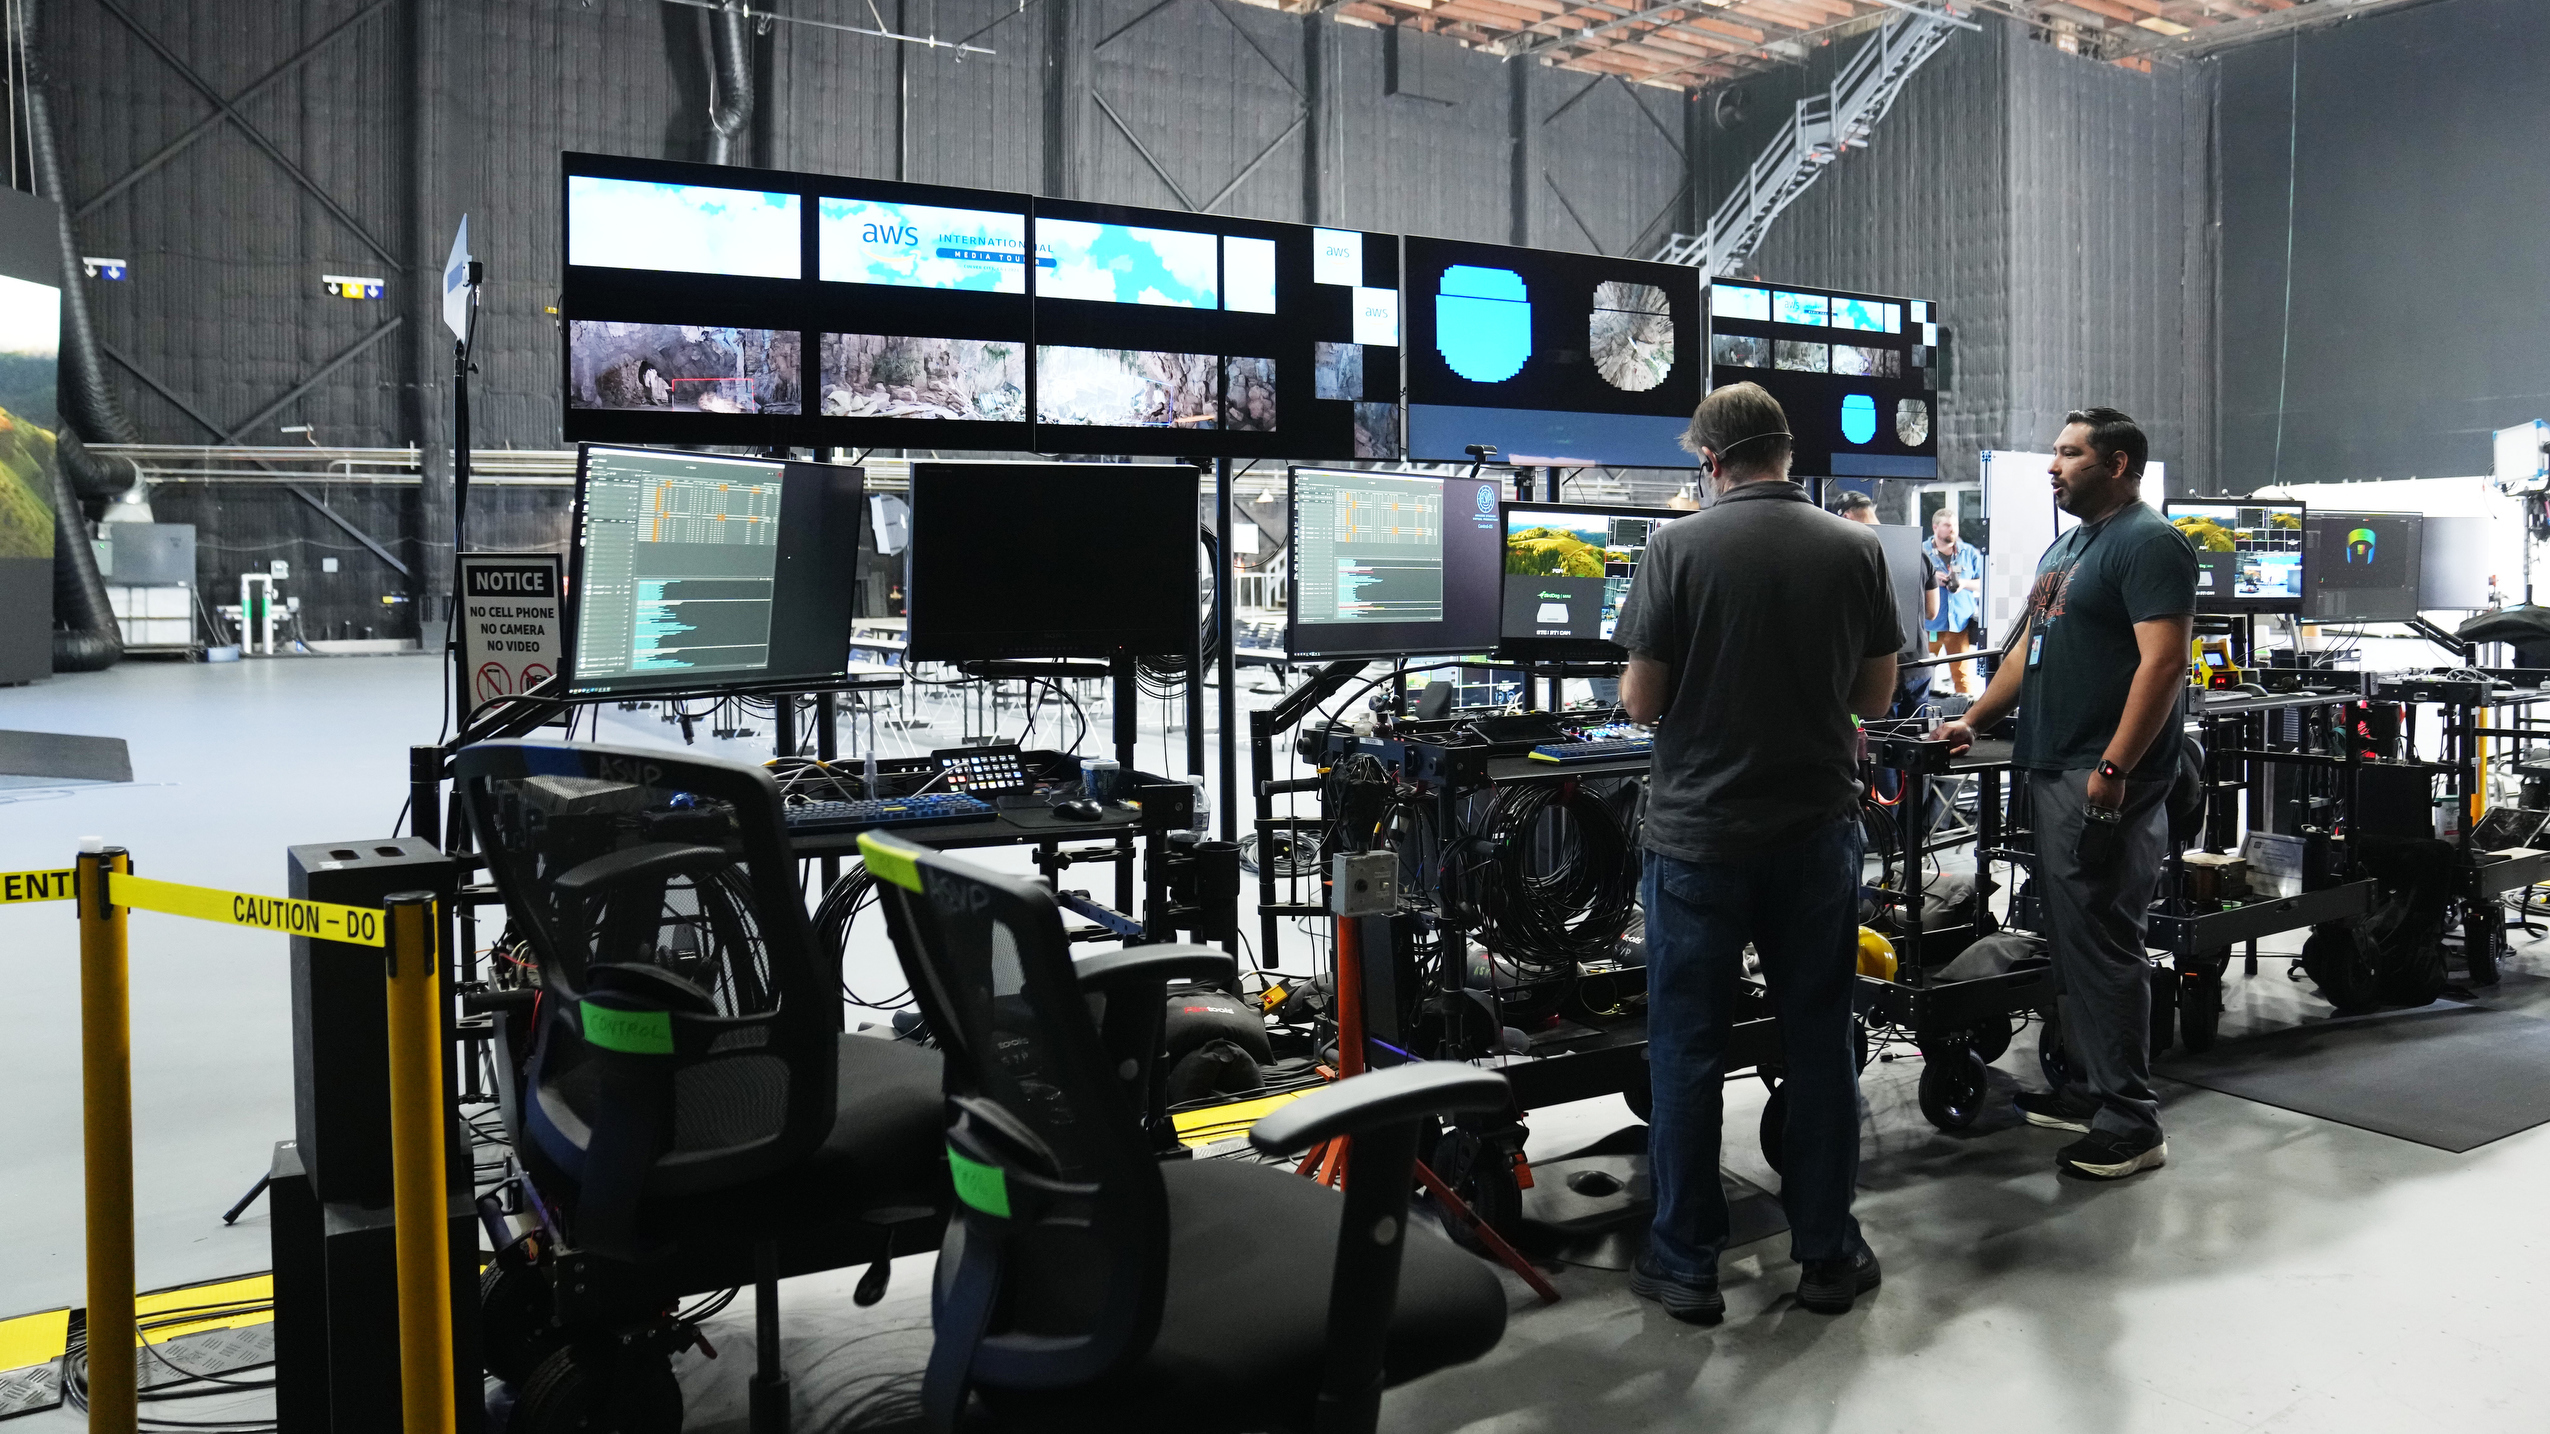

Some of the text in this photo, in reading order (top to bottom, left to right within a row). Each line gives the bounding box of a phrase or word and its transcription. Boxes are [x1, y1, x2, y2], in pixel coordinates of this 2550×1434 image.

[862, 223, 919, 246] aws
[955, 251, 991, 260] MEDIA
[1326, 246, 1350, 258] aws
[1365, 307, 1388, 318] aws
[476, 571, 545, 591] NOTICE
[470, 606, 554, 619] NO CELL PHONE
[481, 623, 545, 636] NO CAMERA
[487, 640, 540, 652] NO VIDEO
[4, 871, 78, 901] ENT
[234, 895, 319, 934] CAUTION
[347, 910, 375, 941] DO
[589, 1014, 667, 1040] CONTROL
